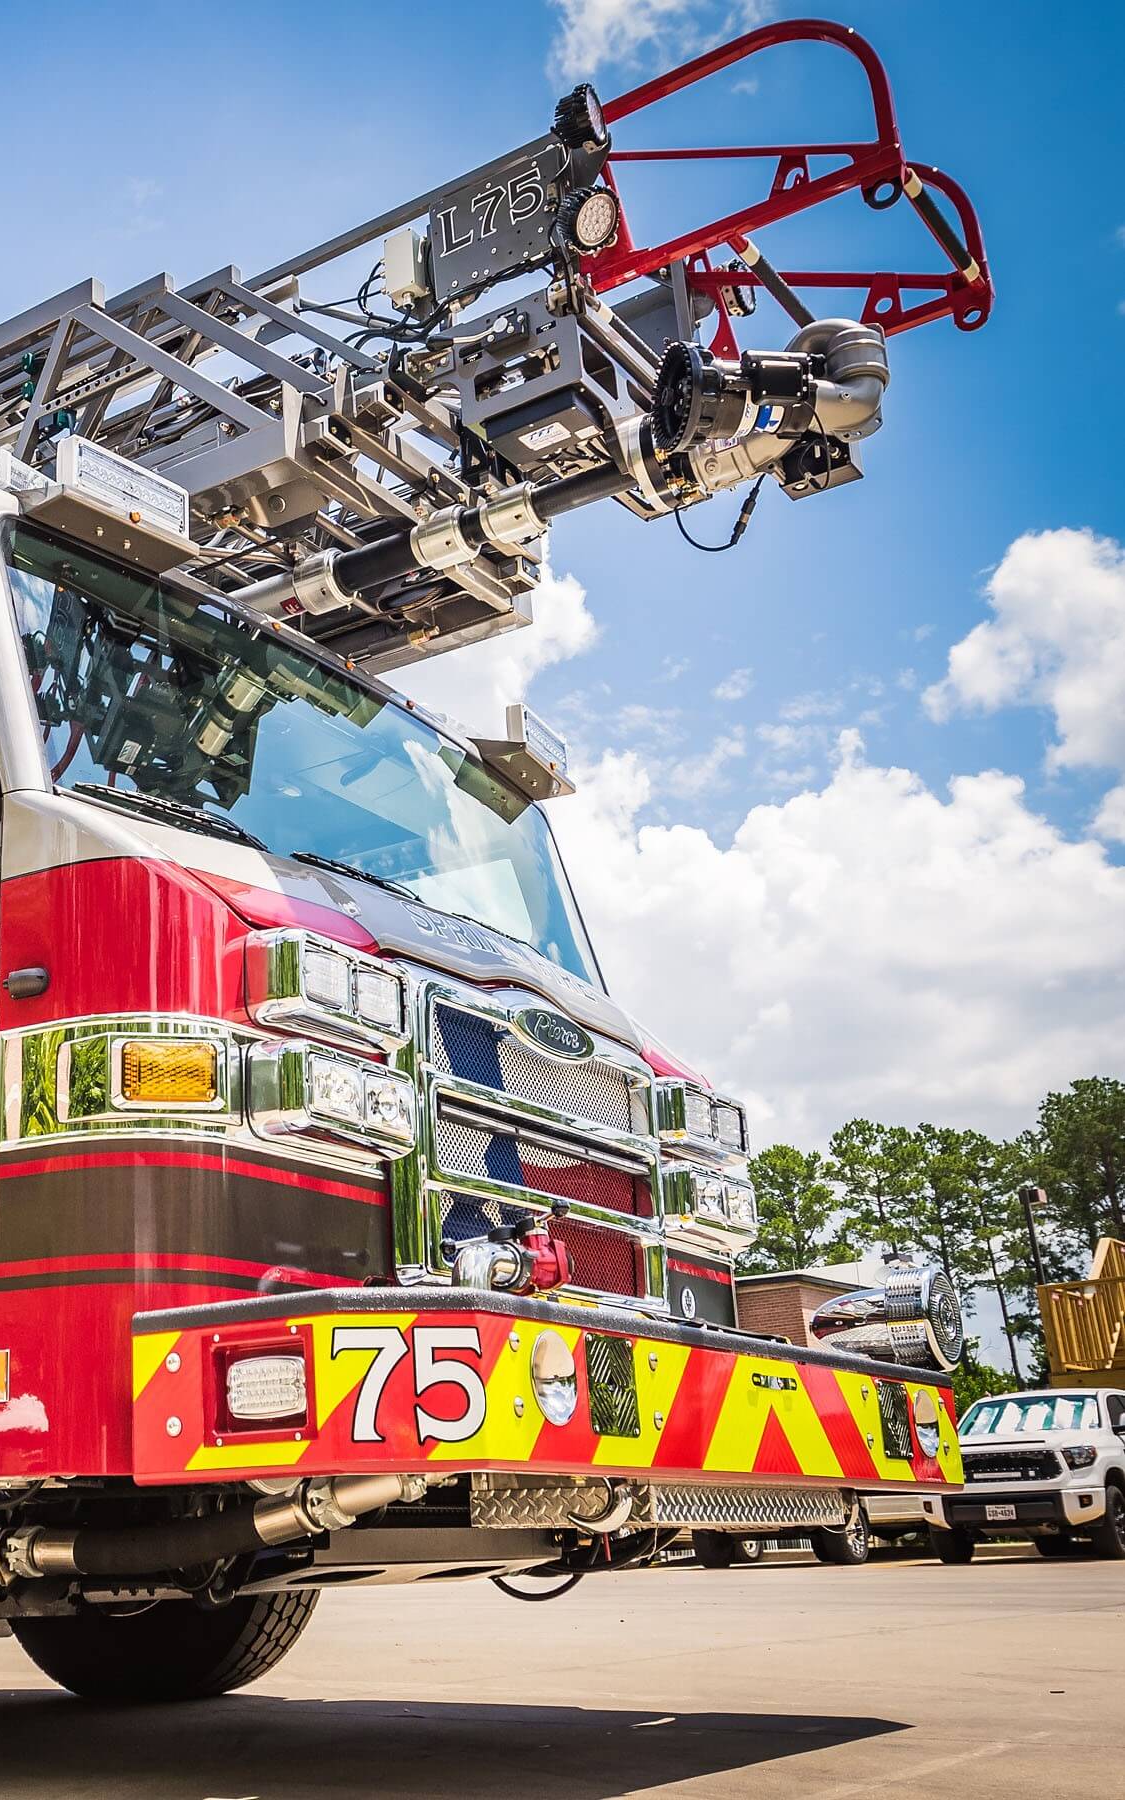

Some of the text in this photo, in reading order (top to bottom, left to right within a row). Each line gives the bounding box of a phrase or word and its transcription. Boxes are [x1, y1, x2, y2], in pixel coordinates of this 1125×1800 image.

[437, 167, 544, 257] L75
[534, 1012, 580, 1049] Pierce
[330, 1326, 487, 1446] 75
